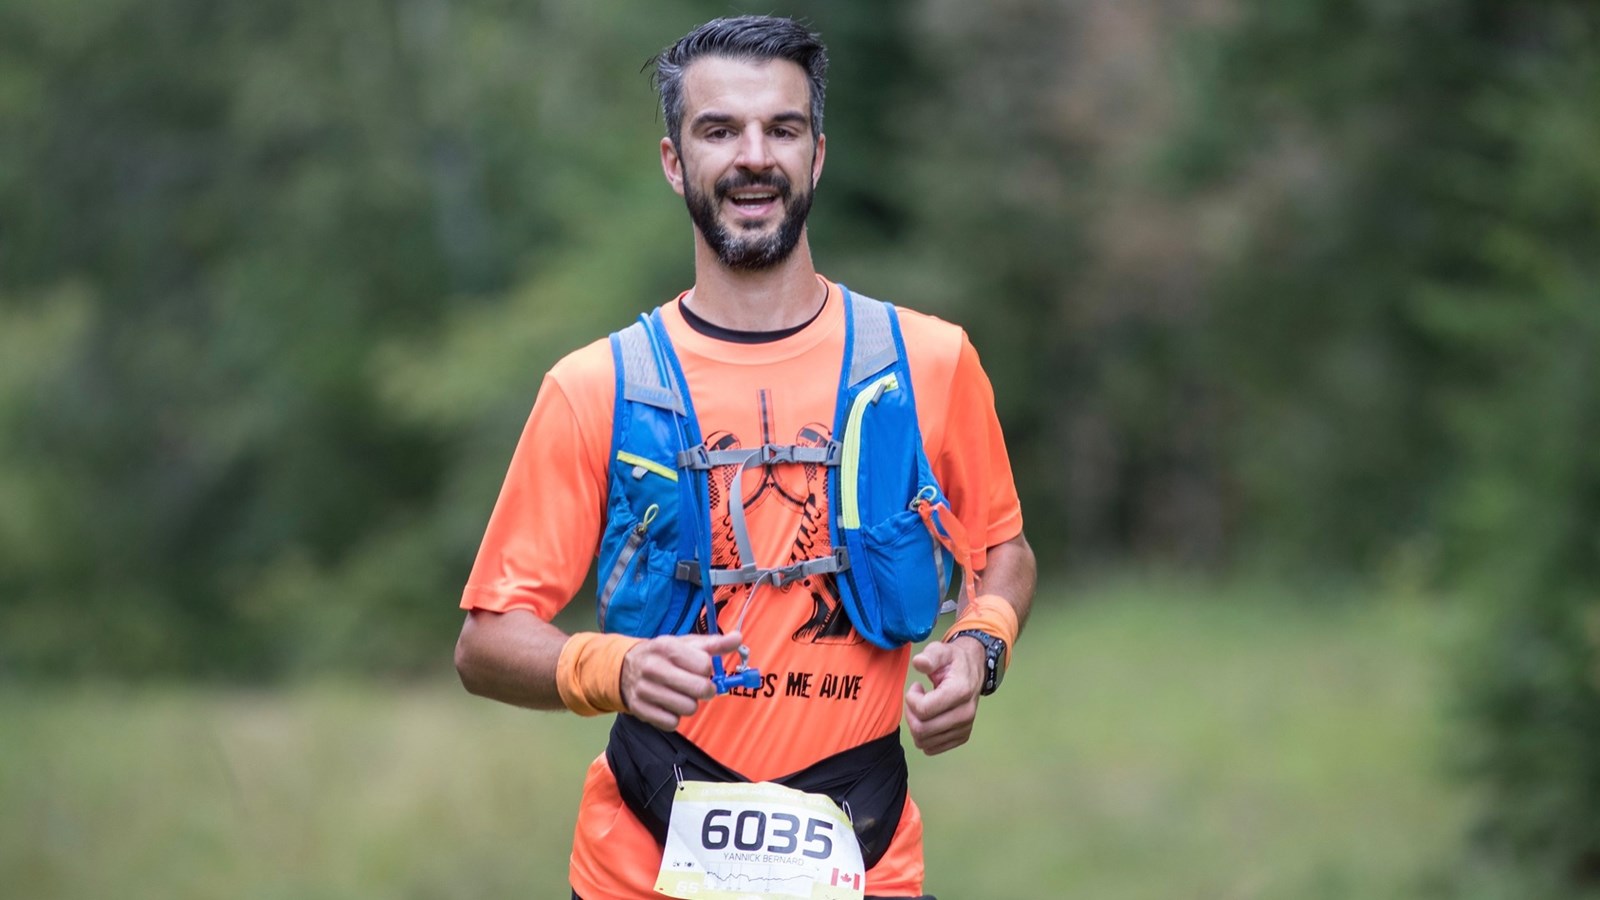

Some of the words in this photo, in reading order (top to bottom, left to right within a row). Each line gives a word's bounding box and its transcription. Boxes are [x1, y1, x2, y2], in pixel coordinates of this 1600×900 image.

[785, 671, 813, 699] ME
[701, 808, 834, 860] 6035
[723, 852, 761, 863] YANNICK
[762, 854, 805, 867] BERNARD
